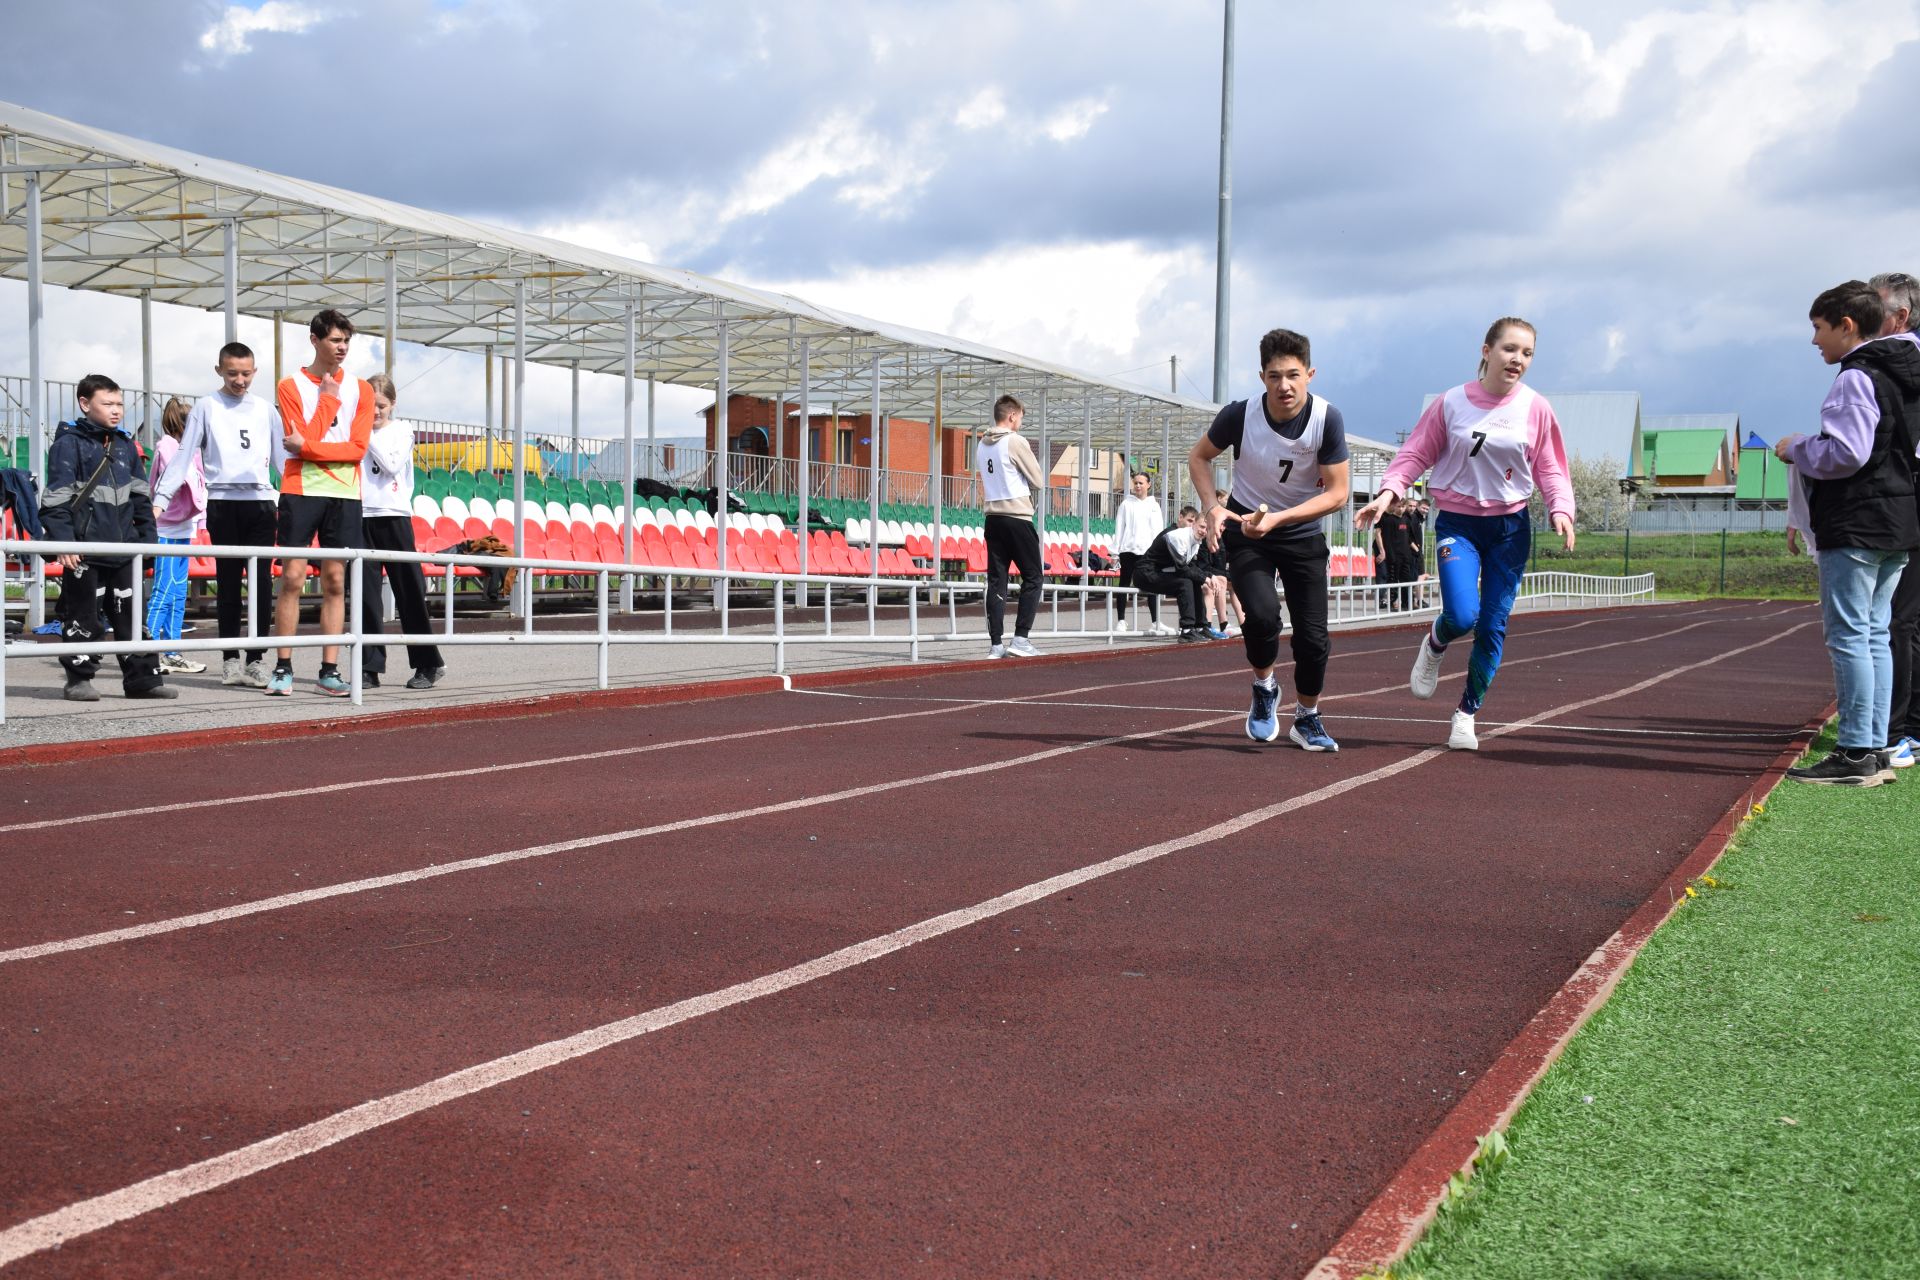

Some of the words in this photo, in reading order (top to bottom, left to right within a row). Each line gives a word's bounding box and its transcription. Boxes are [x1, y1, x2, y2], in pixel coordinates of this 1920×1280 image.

[239, 429, 251, 450] 5
[1469, 430, 1487, 457] 7
[987, 458, 994, 474] 8
[1278, 459, 1294, 483] 7
[1316, 477, 1325, 488] 4
[1505, 468, 1513, 481] 3
[391, 482, 398, 492] 3
